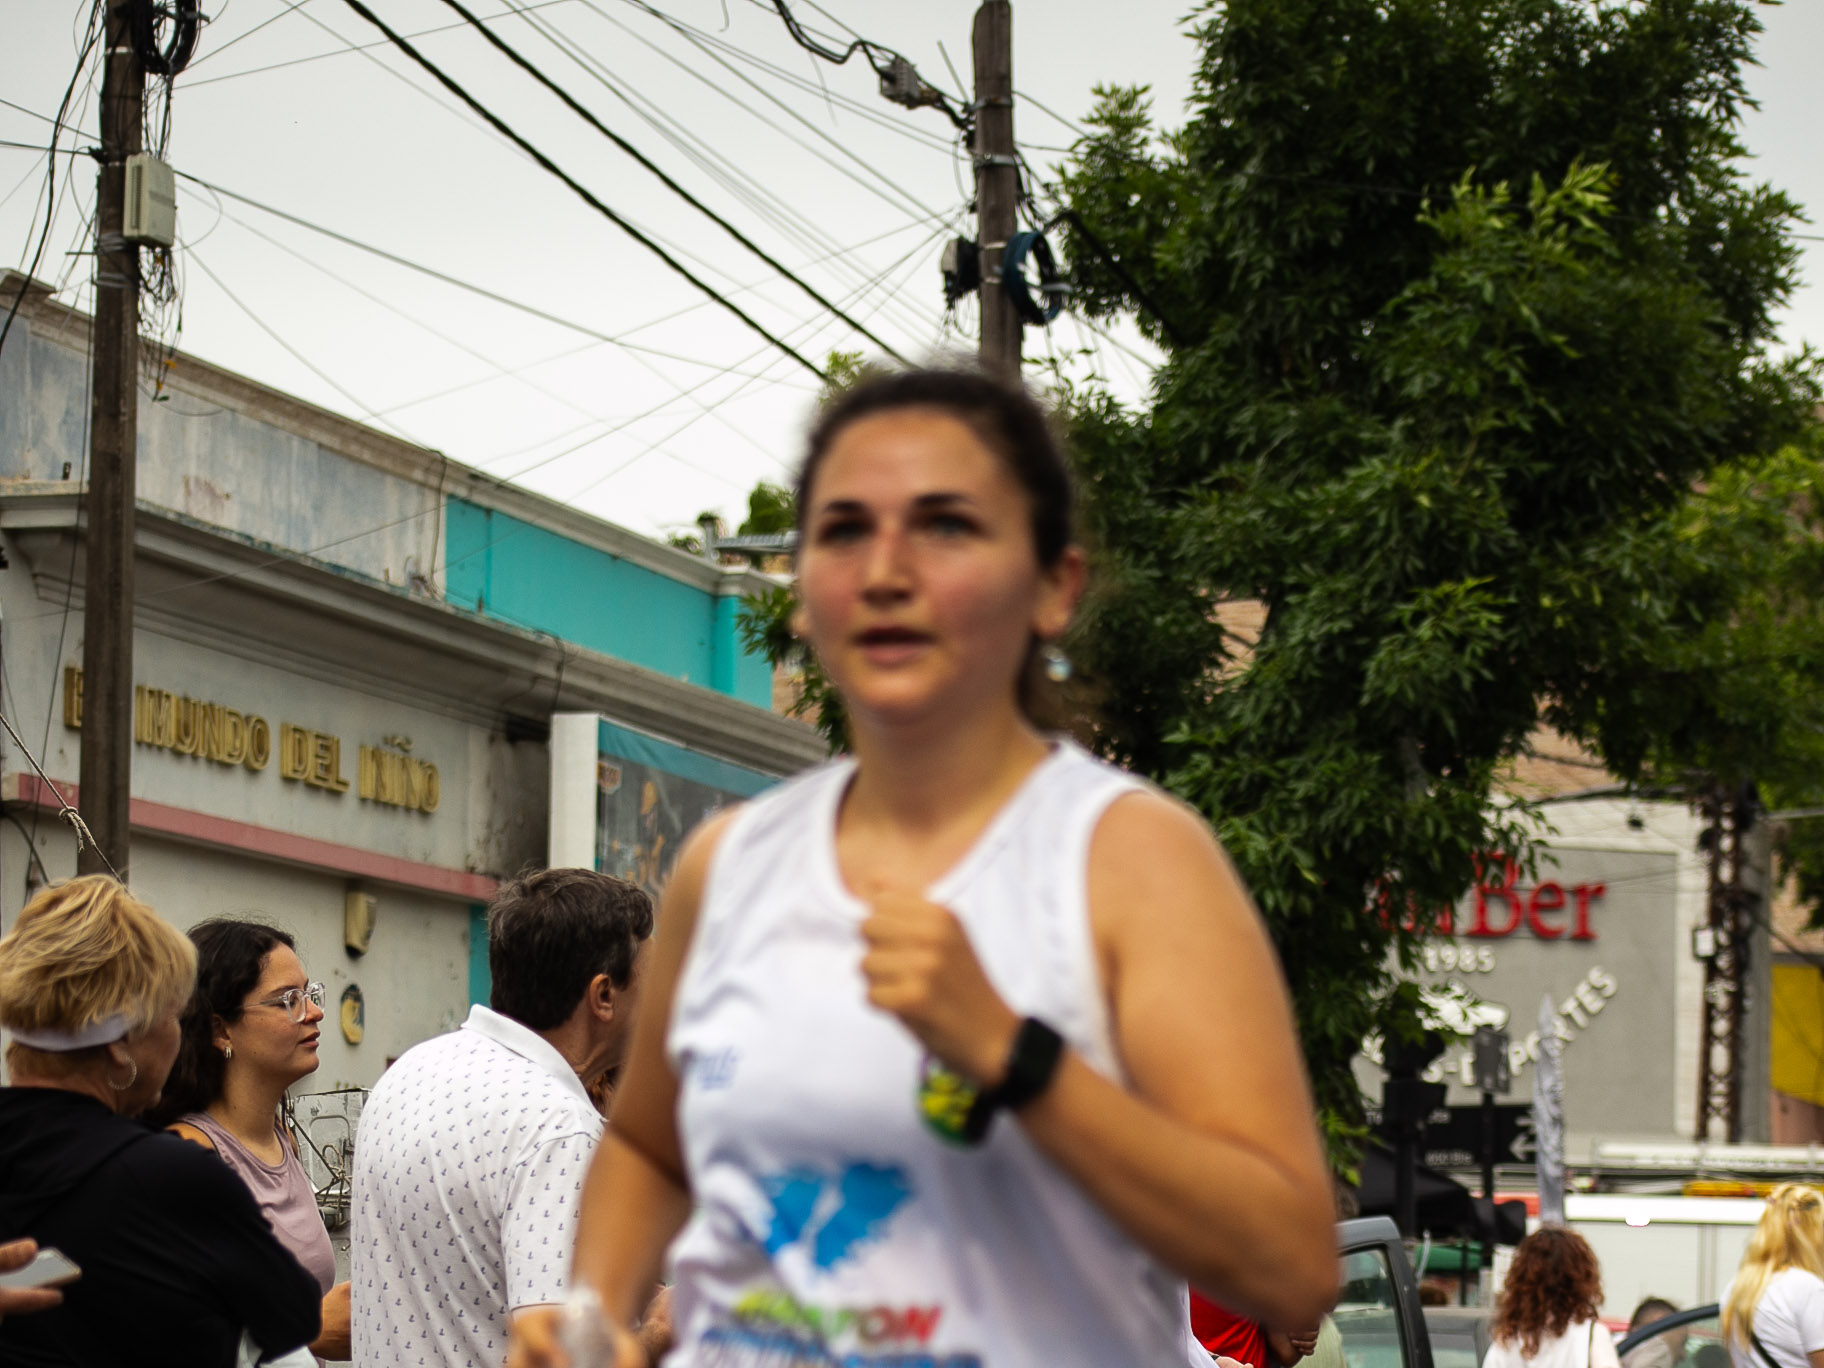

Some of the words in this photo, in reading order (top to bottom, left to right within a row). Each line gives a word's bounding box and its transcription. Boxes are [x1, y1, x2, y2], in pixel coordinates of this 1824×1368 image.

[135, 684, 271, 771] MUNDO
[280, 722, 350, 793] DEL
[358, 735, 441, 814] NIÑO
[1423, 944, 1496, 974] 1985
